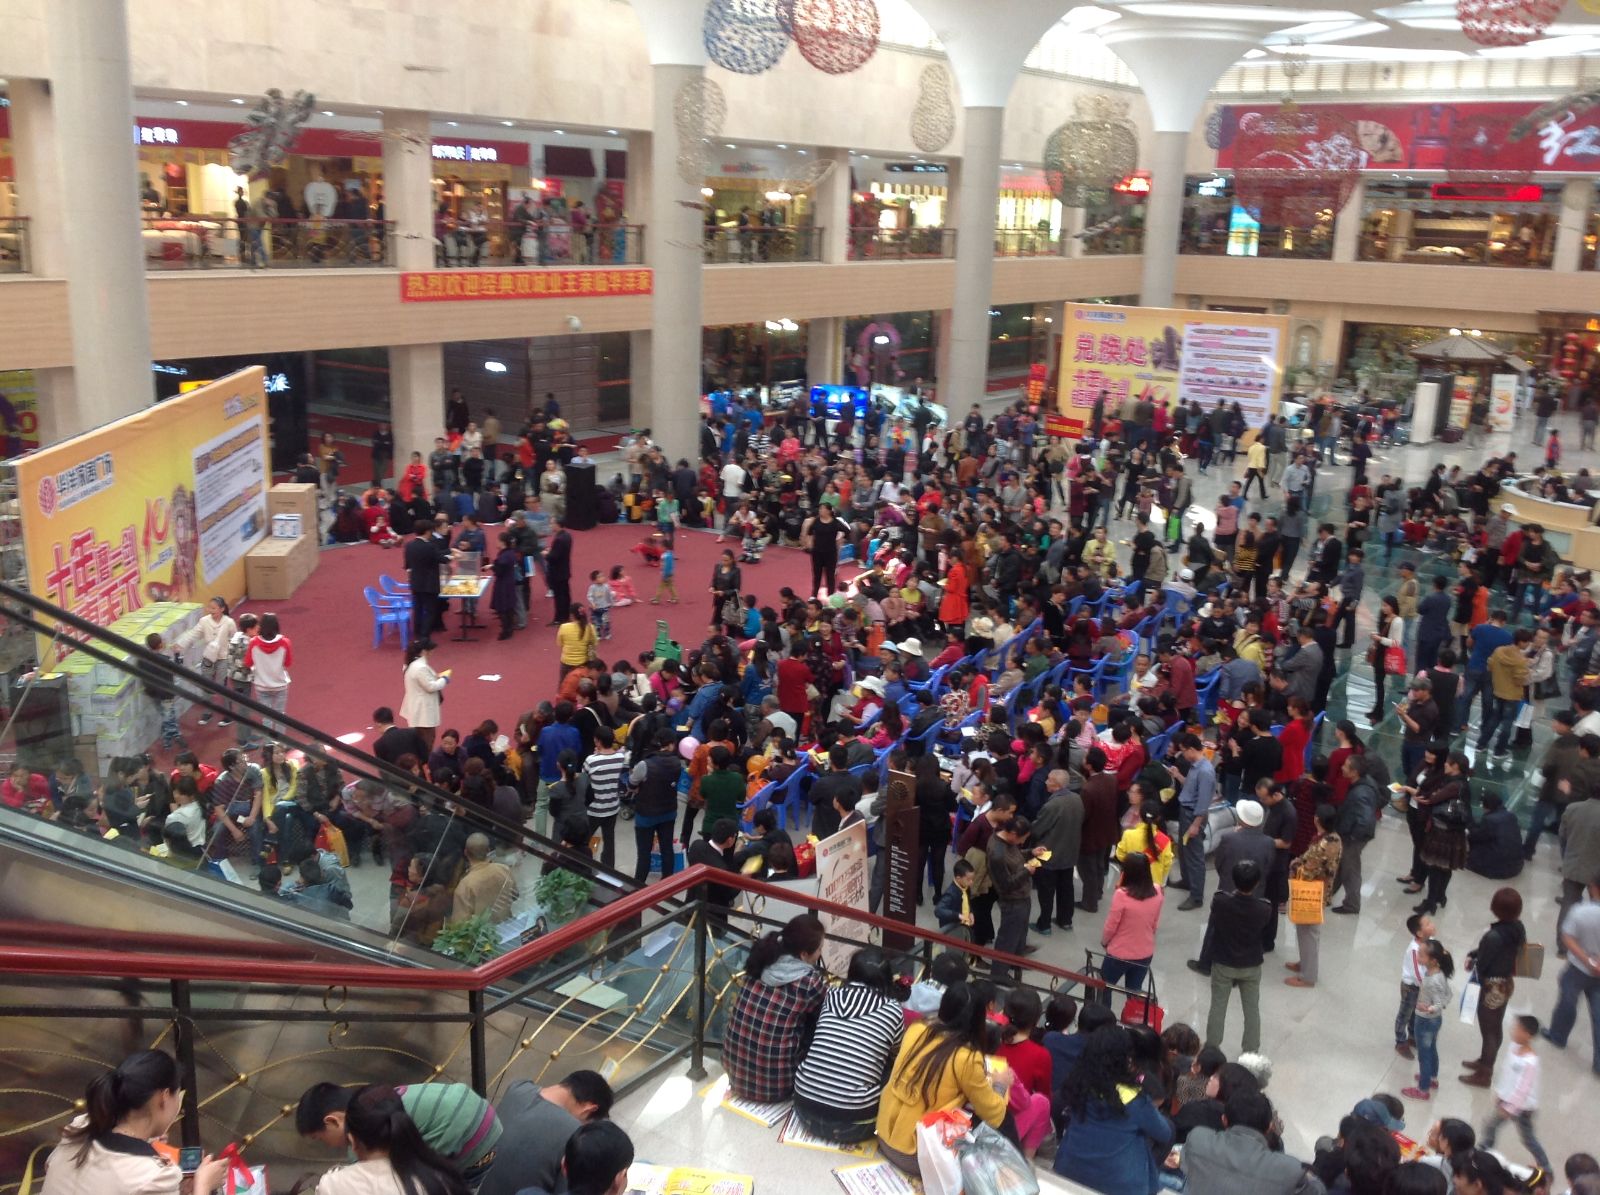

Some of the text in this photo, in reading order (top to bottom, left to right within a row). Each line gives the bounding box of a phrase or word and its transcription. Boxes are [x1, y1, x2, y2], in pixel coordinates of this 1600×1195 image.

[1073, 332, 1148, 367] 兑换处
[142, 496, 173, 571] 10
